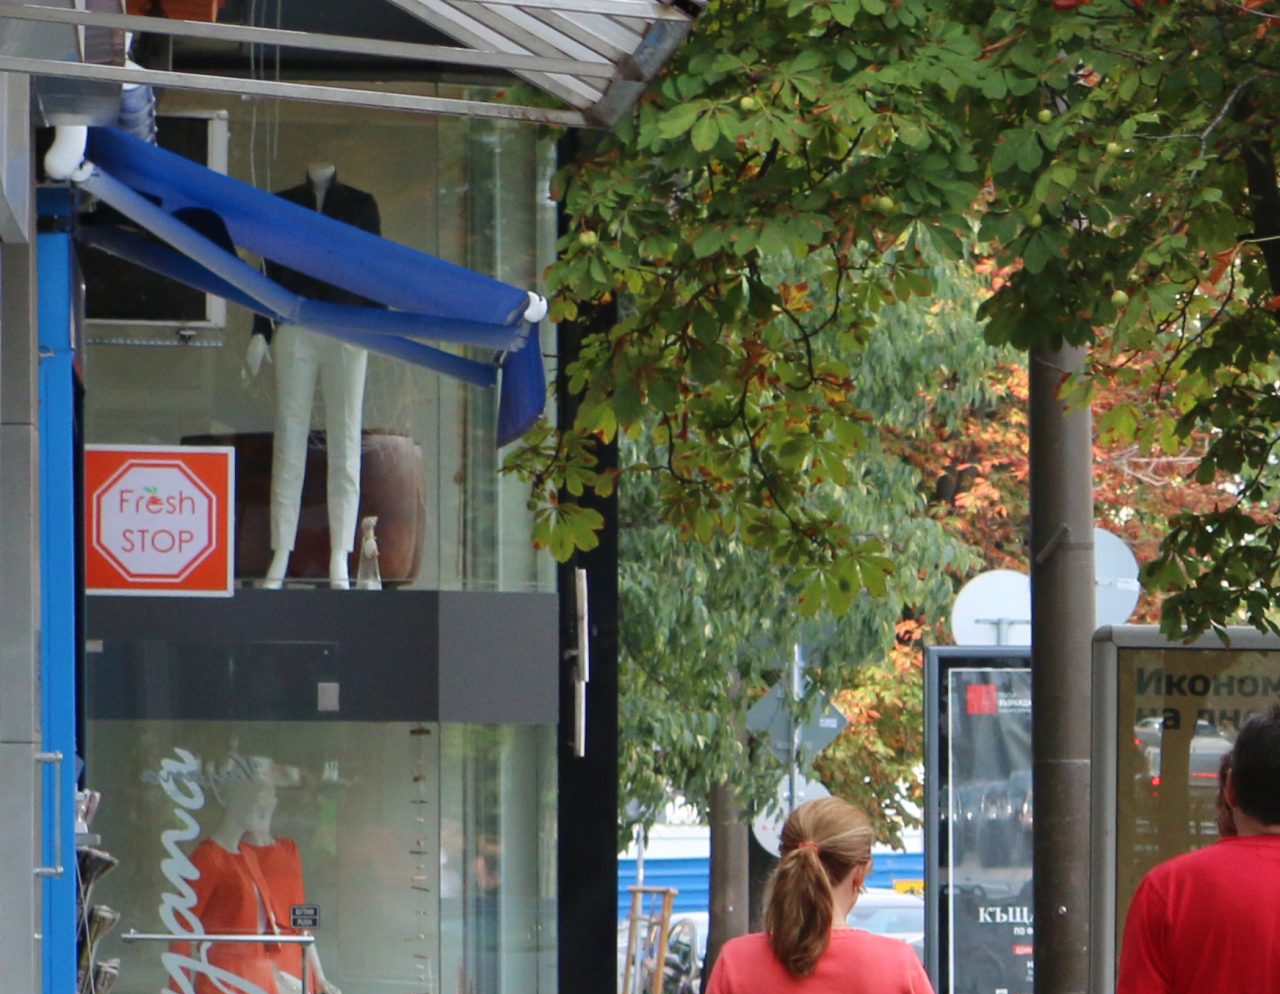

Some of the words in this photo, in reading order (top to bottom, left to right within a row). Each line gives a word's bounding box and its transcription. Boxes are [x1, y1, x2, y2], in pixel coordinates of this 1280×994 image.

[119, 488, 195, 515] Fresh
[121, 528, 194, 553] STOP
[978, 906, 1034, 925] КЪЩ
